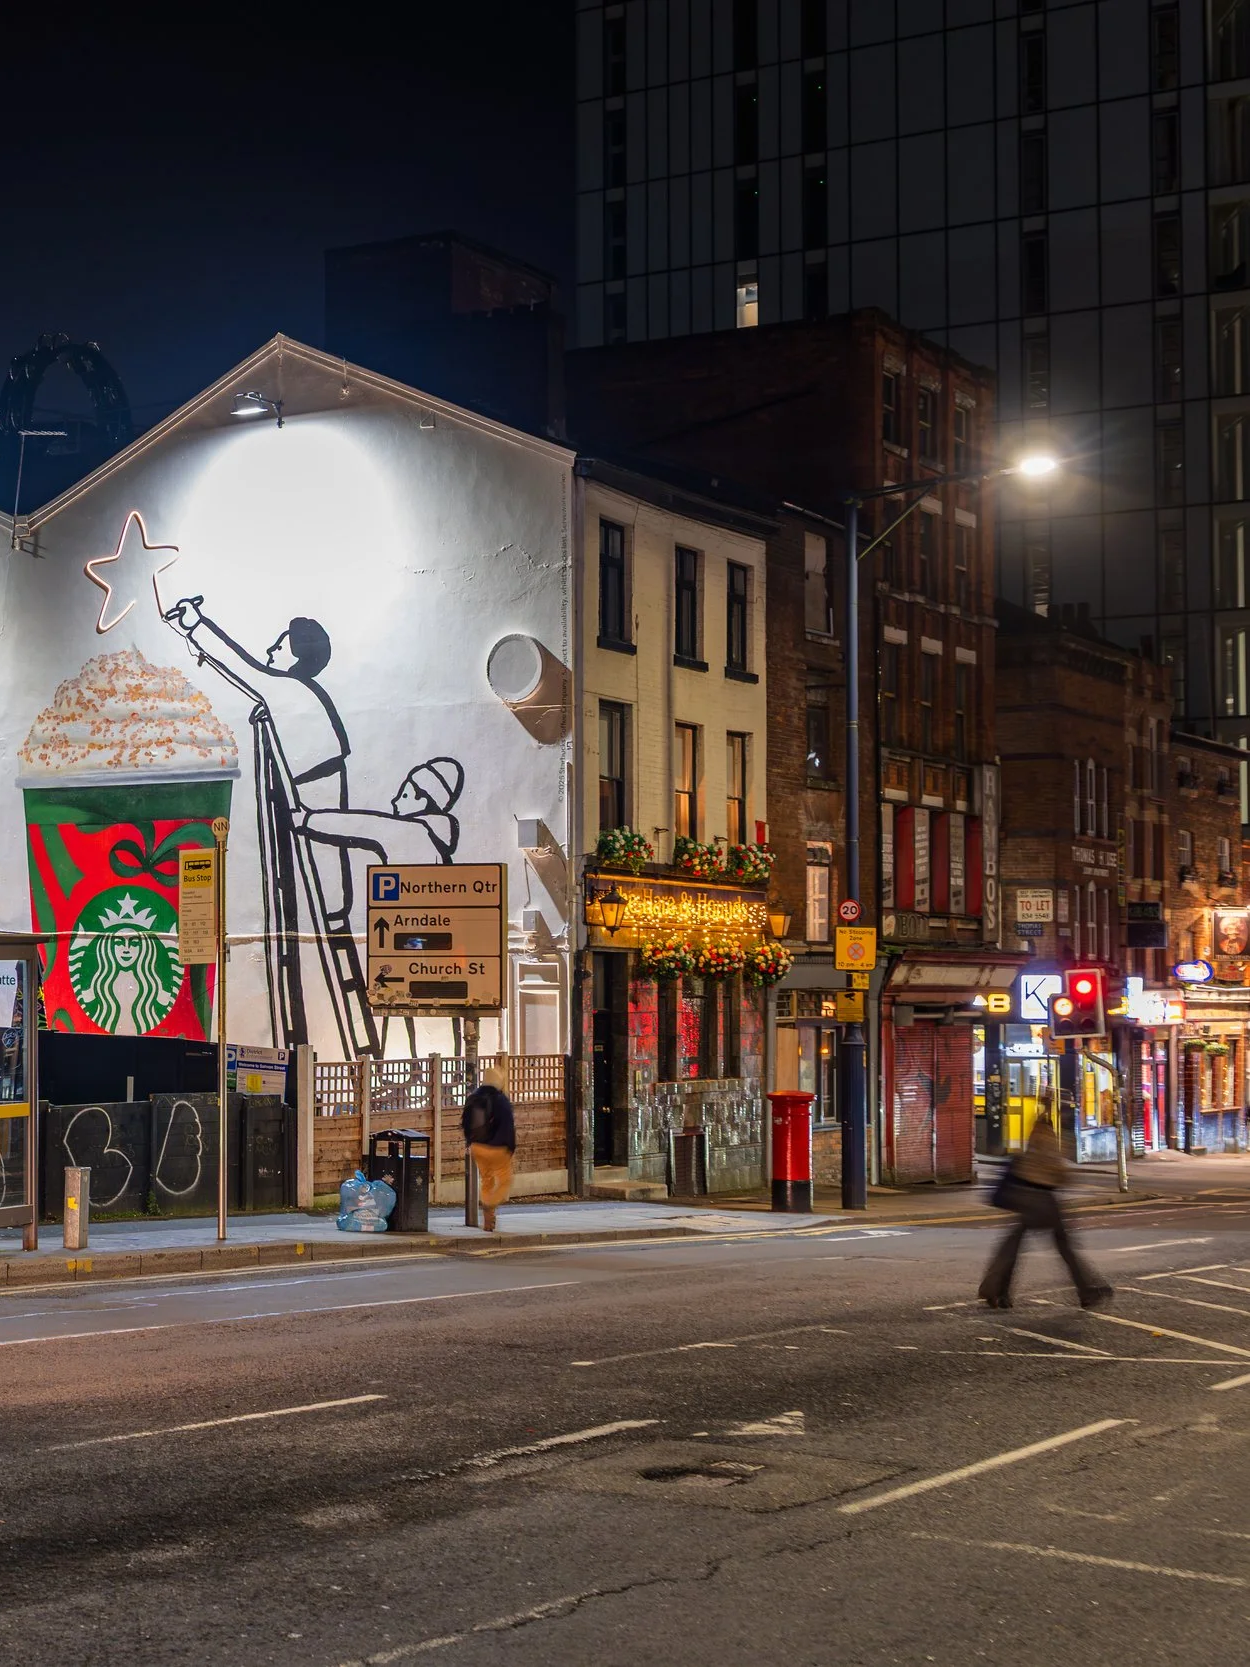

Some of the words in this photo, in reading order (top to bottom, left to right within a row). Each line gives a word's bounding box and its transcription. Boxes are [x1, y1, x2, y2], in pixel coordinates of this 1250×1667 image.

[560, 597, 569, 638] availability,
[561, 639, 568, 647] to
[558, 739, 567, 774] Starbucks
[213, 821, 229, 832] NN
[196, 874, 212, 883] Stop
[379, 876, 396, 899] P
[400, 881, 467, 894] Northern
[472, 880, 497, 893] Qtr
[638, 888, 677, 915] Hare
[679, 891, 693, 917] &
[697, 892, 749, 921] Hounds
[842, 906, 858, 915] 20
[1019, 900, 1032, 911] TO
[1036, 900, 1050, 911] LET
[394, 914, 450, 926] Arndale
[409, 962, 462, 975] Church
[468, 962, 486, 975] St
